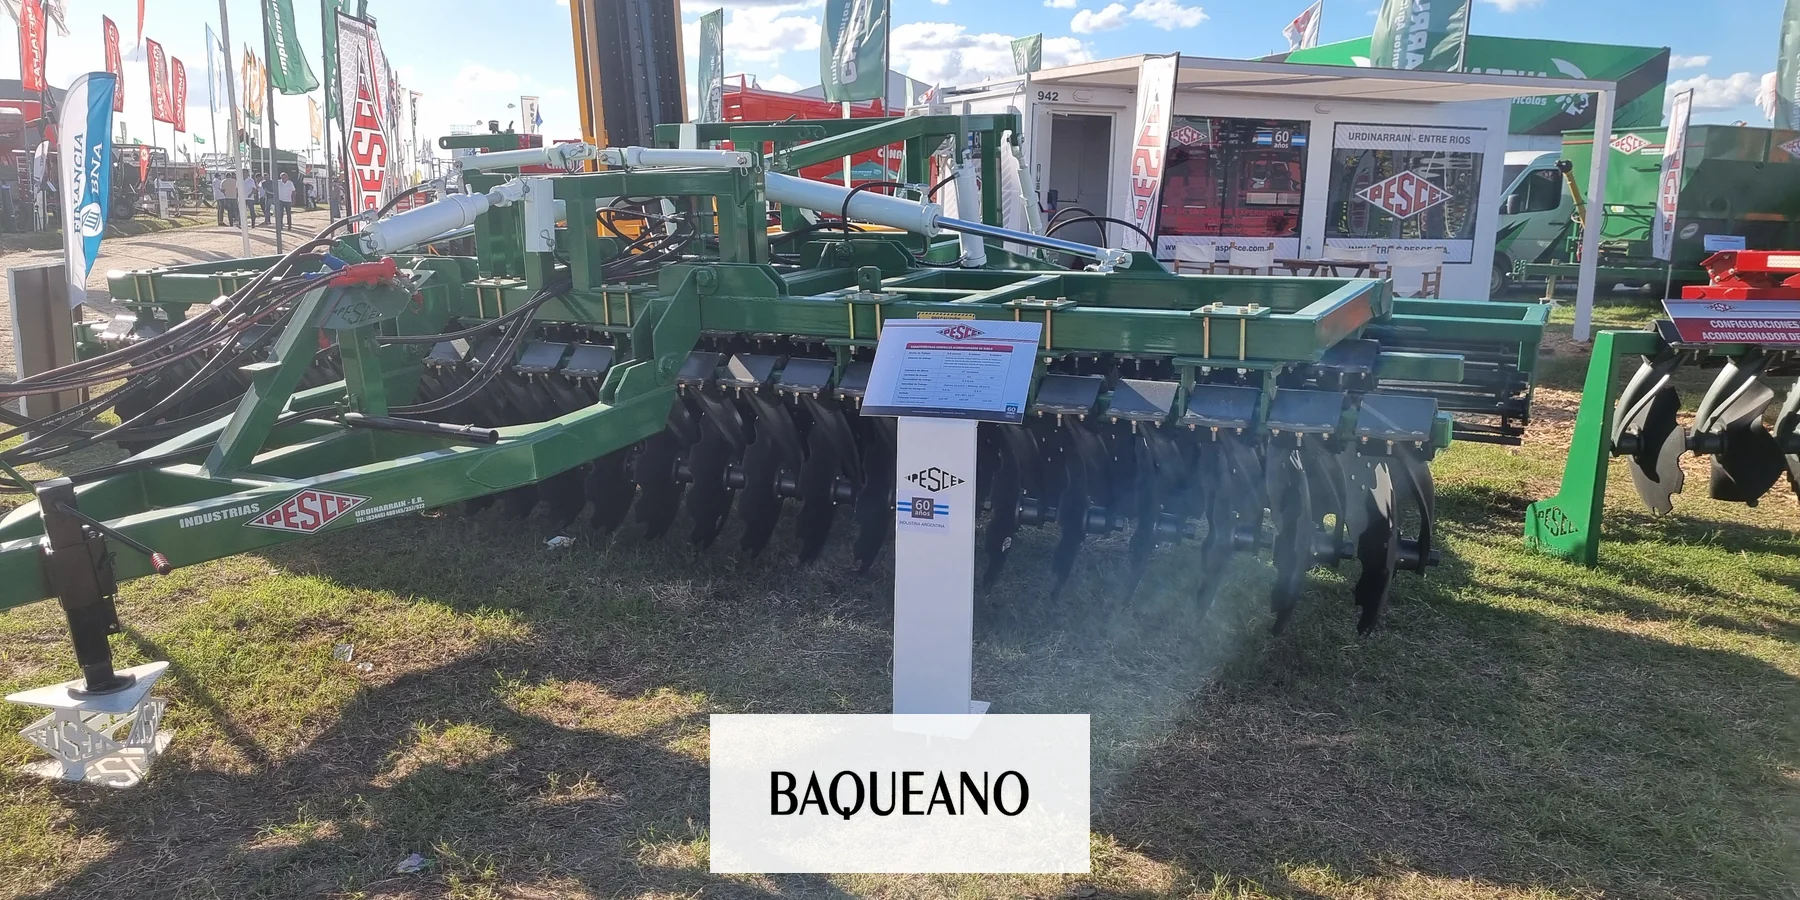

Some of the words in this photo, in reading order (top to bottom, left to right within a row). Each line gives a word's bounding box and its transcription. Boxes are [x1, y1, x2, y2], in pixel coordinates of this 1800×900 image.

[1037, 90, 1059, 101] 942
[1275, 131, 1289, 142] 60
[1348, 132, 1411, 142] URDINARRAIN
[1418, 135, 1448, 143] ENTRE
[1449, 136, 1471, 144] RIOS
[92, 142, 103, 195] BNA
[1369, 172, 1441, 217] PESCE
[1710, 320, 1798, 329] CONFIGURACIONES
[943, 325, 977, 339] PESCE
[1702, 331, 1787, 341] ACONDICIONADOR
[912, 467, 957, 492] PESCE
[179, 503, 260, 529] INDUSTRIAS
[266, 491, 350, 531] PESCE
[355, 500, 406, 517] URDINARRAIN
[915, 500, 930, 511] 60
